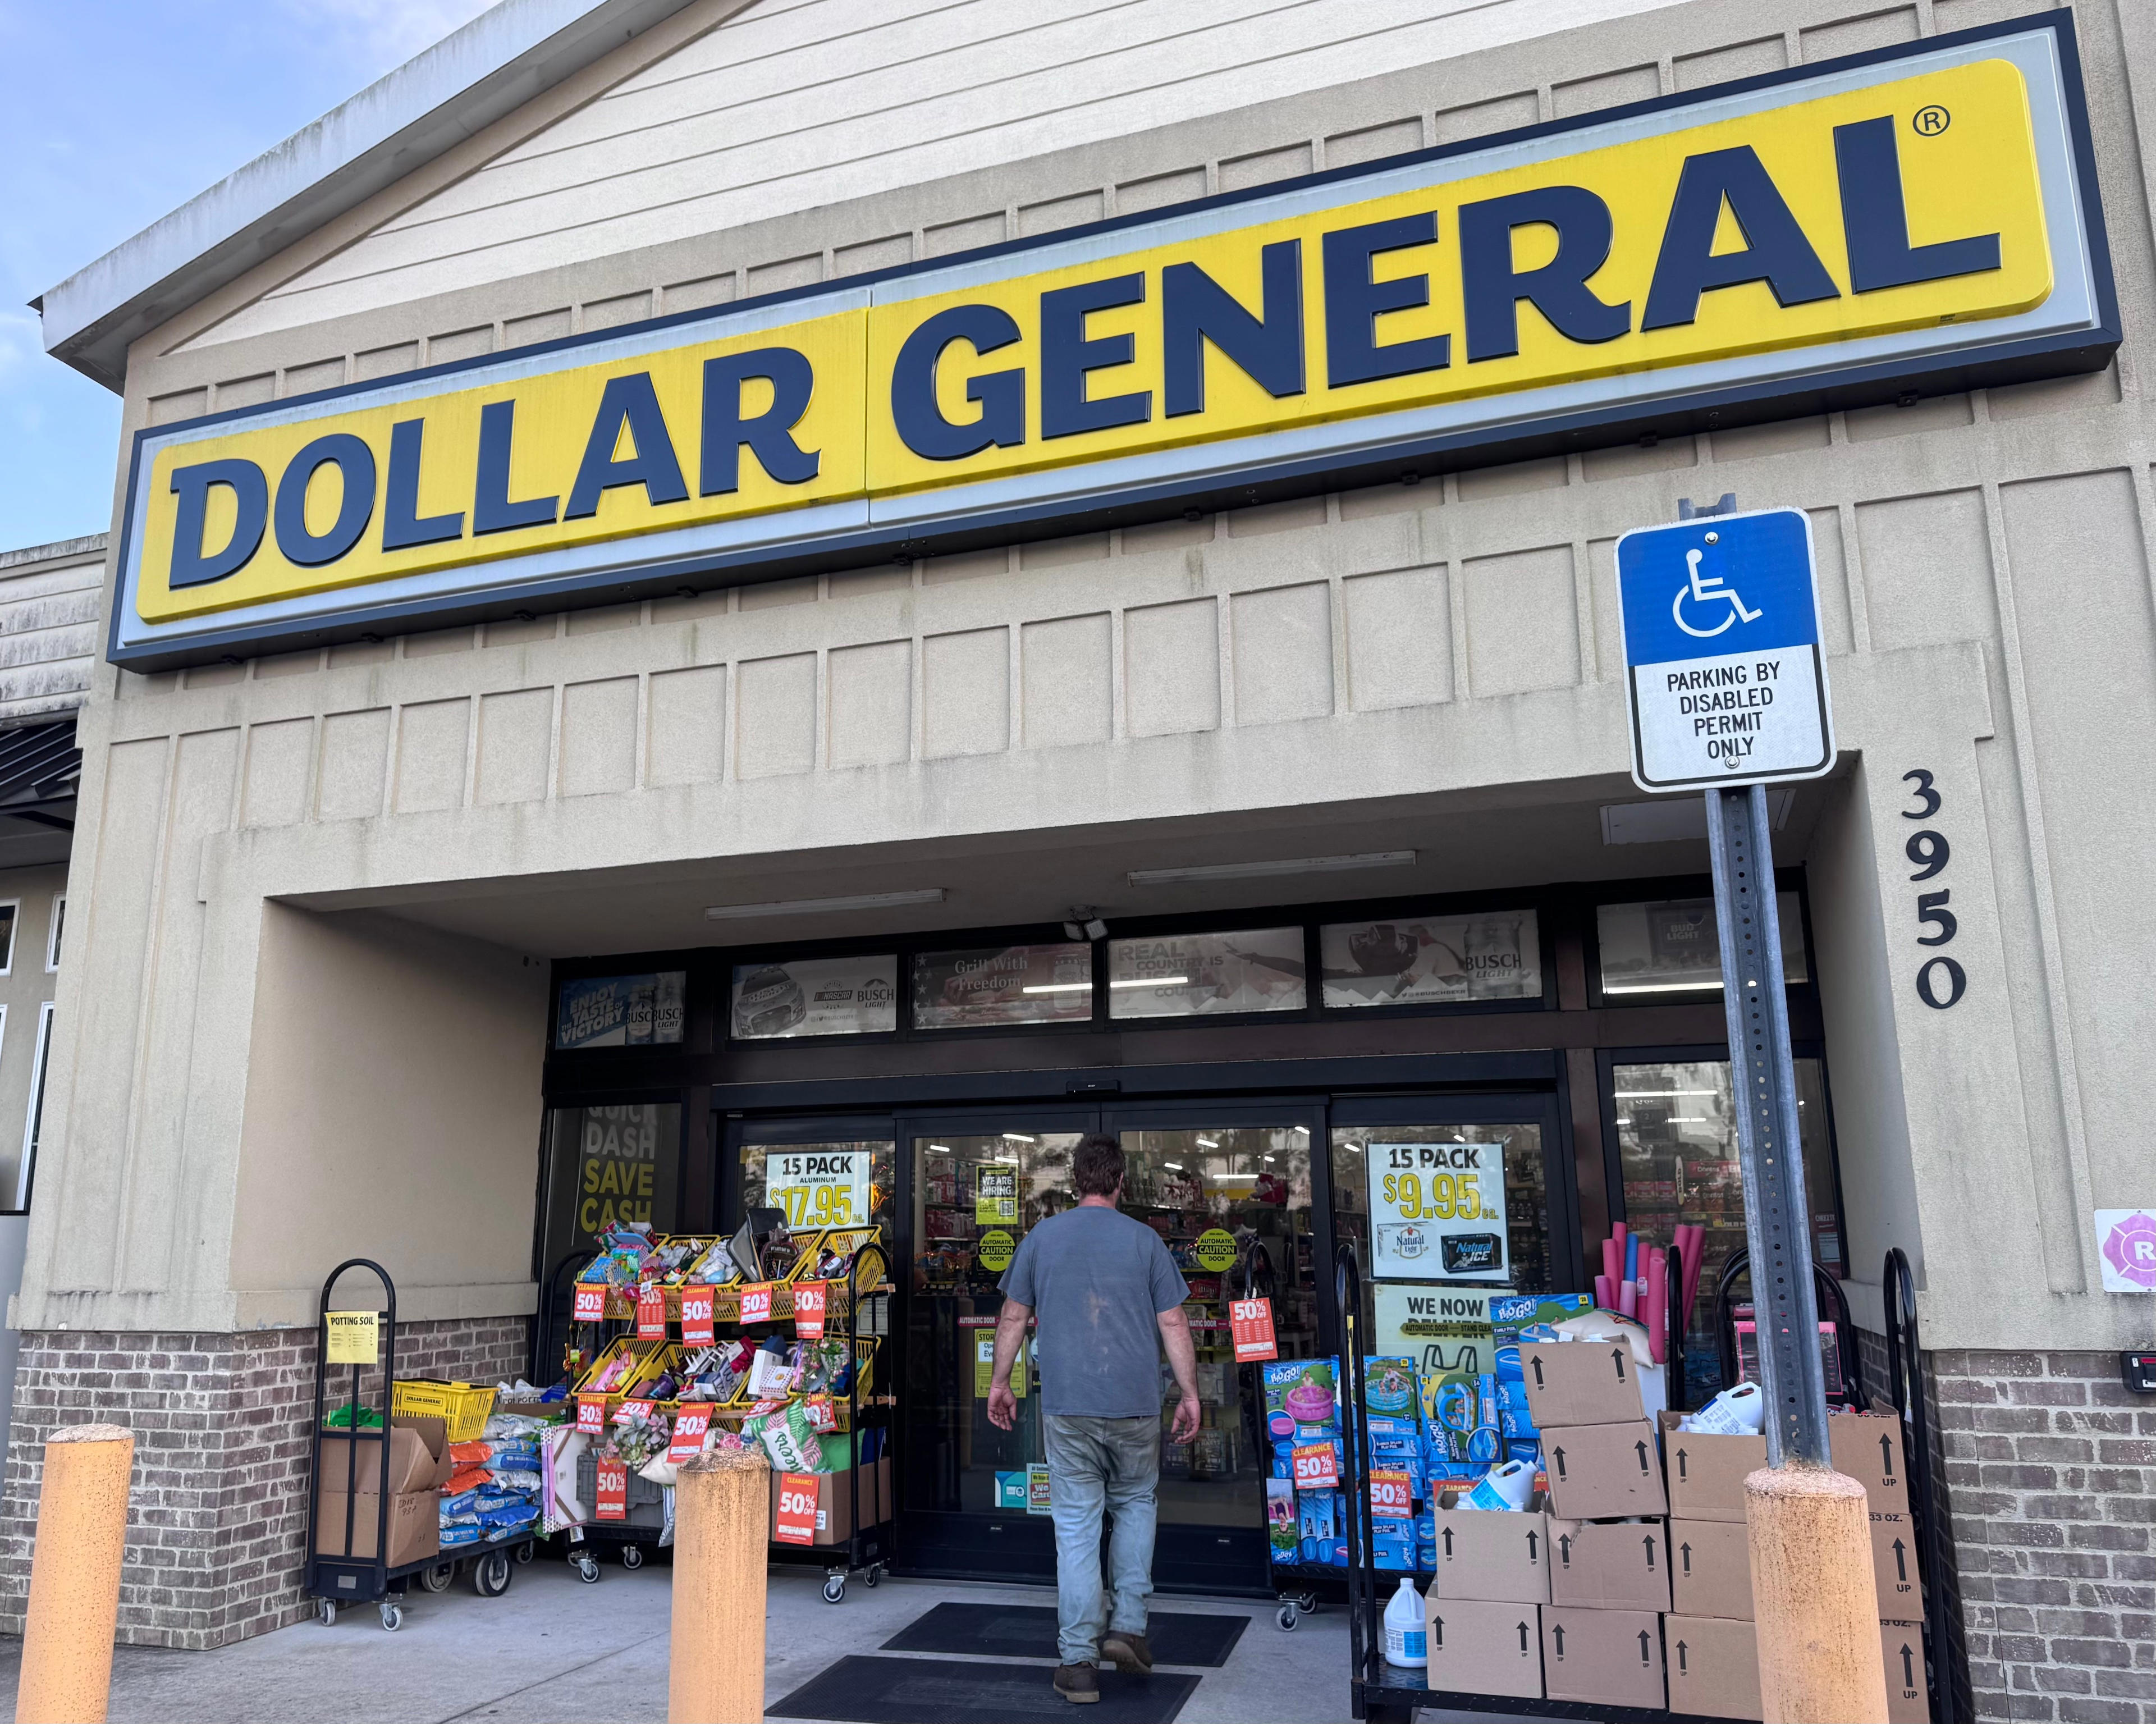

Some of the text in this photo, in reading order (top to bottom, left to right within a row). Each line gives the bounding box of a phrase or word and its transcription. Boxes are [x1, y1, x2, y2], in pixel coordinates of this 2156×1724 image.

[170, 346, 821, 591] DOLLAR
[891, 114, 2002, 461] GENERAL
[1668, 661, 1780, 692] PARKING BY
[1680, 687, 1773, 715] DISABLED
[1694, 711, 1763, 737] PERMIT
[1708, 737, 1754, 760] ONLY
[1902, 769, 1966, 1009] 3950
[1666, 931, 1701, 940] LIGHT
[1670, 925, 1694, 933] BUD
[1119, 942, 1184, 961] REAL
[955, 956, 1028, 974] Grill With
[1137, 956, 1224, 971] COUNTRY IS
[1466, 954, 1522, 971] BUSCH
[1476, 969, 1513, 978] LIGHT
[958, 975, 1025, 991] Freedom.
[570, 982, 618, 1014] ENJOY
[823, 990, 851, 1000] NASCAR
[858, 988, 894, 1002] BUSCH
[573, 998, 614, 1025] TASTE
[865, 1001, 886, 1010] LIGHT
[653, 1008, 684, 1022] BUSCH
[561, 1007, 625, 1044] VICTORY
[585, 1122, 656, 1159] DASH
[782, 1156, 853, 1176] 15 PACK
[1389, 1149, 1481, 1169] 15 PACK
[583, 1158, 655, 1196] SAVE
[982, 1176, 1011, 1186] WE ARE
[982, 1186, 1012, 1196] HIRING
[1383, 1173, 1499, 1220] $9.95 ea.
[770, 1185, 852, 1226] $17.95
[580, 1197, 652, 1233] CASH
[1397, 1234, 1425, 1246] Natural
[1456, 1242, 1493, 1254] Natural
[981, 1246, 1014, 1255] CAUTION
[1198, 1246, 1235, 1254] CAUTION
[1470, 1251, 1491, 1262] ICE
[2134, 1241, 2156, 1260] R
[640, 1288, 661, 1304] 50%
[742, 1283, 771, 1293] CLEARANCE
[577, 1293, 602, 1310] 50%
[742, 1293, 768, 1313] 50%
[795, 1291, 824, 1311] 50%
[1407, 1297, 1484, 1317] WE NOW
[683, 1300, 712, 1321] 50%
[1234, 1300, 1266, 1321] 50%
[331, 1316, 374, 1325] POTTING SOIL
[579, 1394, 607, 1403] CLEARANCE
[579, 1405, 602, 1423] 50%
[619, 1402, 651, 1415] 50%
[674, 1416, 707, 1435] 50%
[1293, 1443, 1331, 1457] CLEARANCE
[1296, 1455, 1332, 1476] 50%
[598, 1472, 625, 1492] 50%
[787, 1477, 813, 1485] CLEARANCE
[1370, 1471, 1408, 1481] CLEARANCE
[1882, 1478, 1897, 1487] UP
[1371, 1483, 1407, 1504] 50%
[780, 1491, 815, 1515] 50%
[1897, 1584, 1912, 1593] UP
[1903, 1690, 1918, 1700] UP
